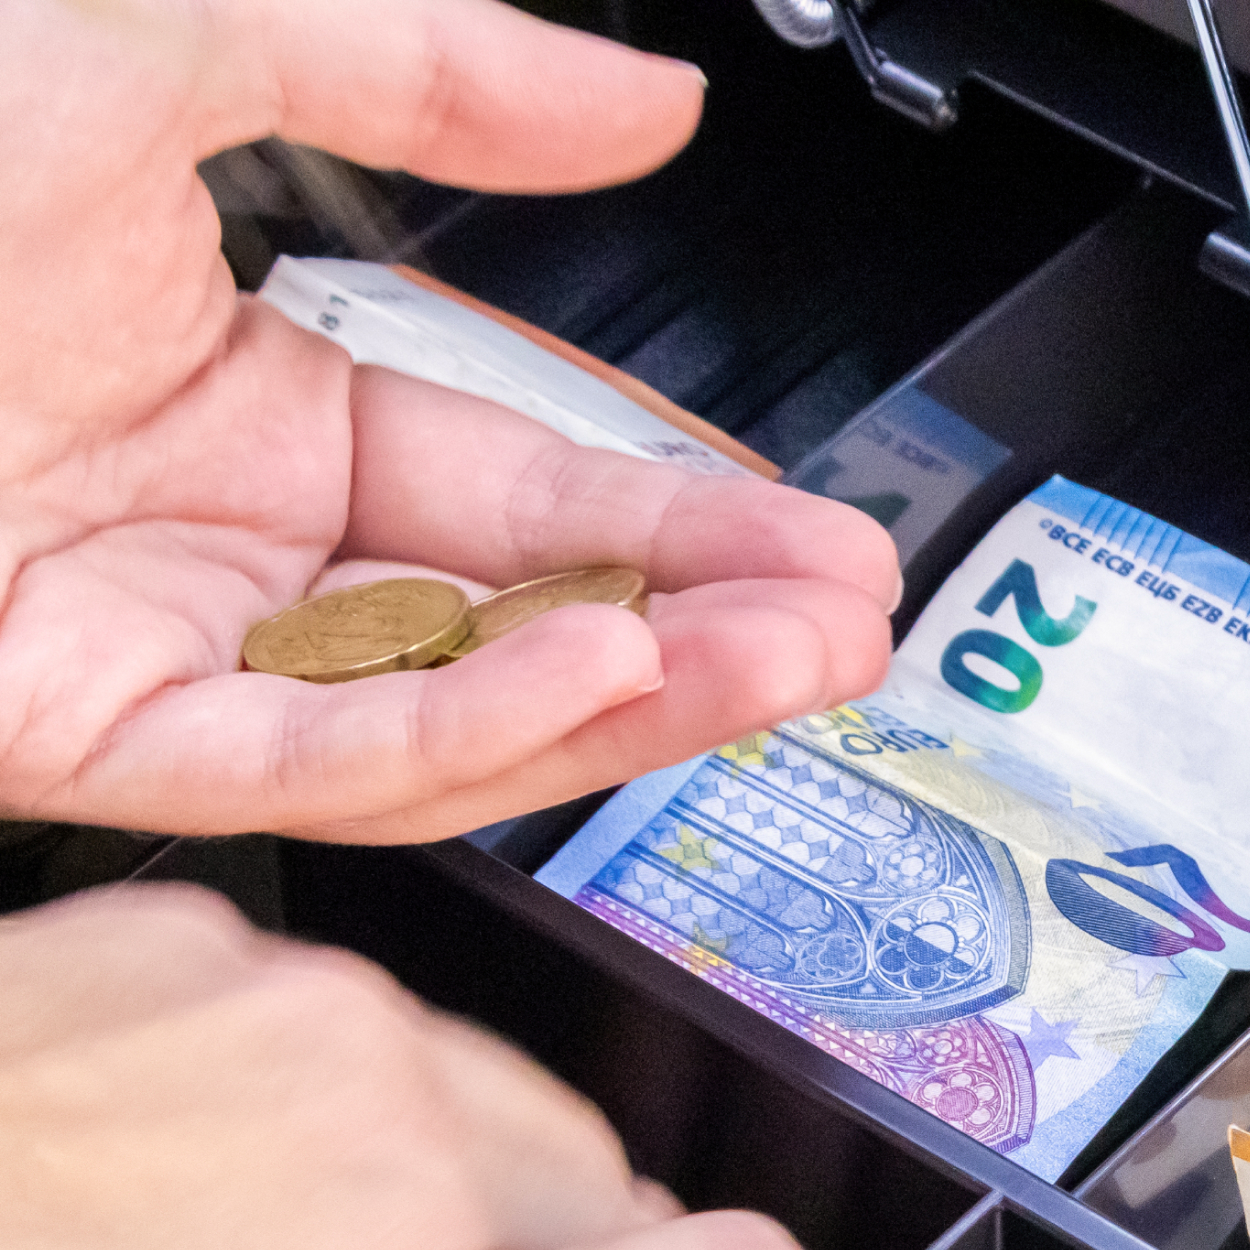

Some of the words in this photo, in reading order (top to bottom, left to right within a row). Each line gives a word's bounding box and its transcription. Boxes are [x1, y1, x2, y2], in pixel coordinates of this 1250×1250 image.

[1091, 547, 1135, 577] ECB
[1180, 593, 1223, 624] EZB
[940, 557, 1098, 714] 20
[839, 728, 950, 756] EURO
